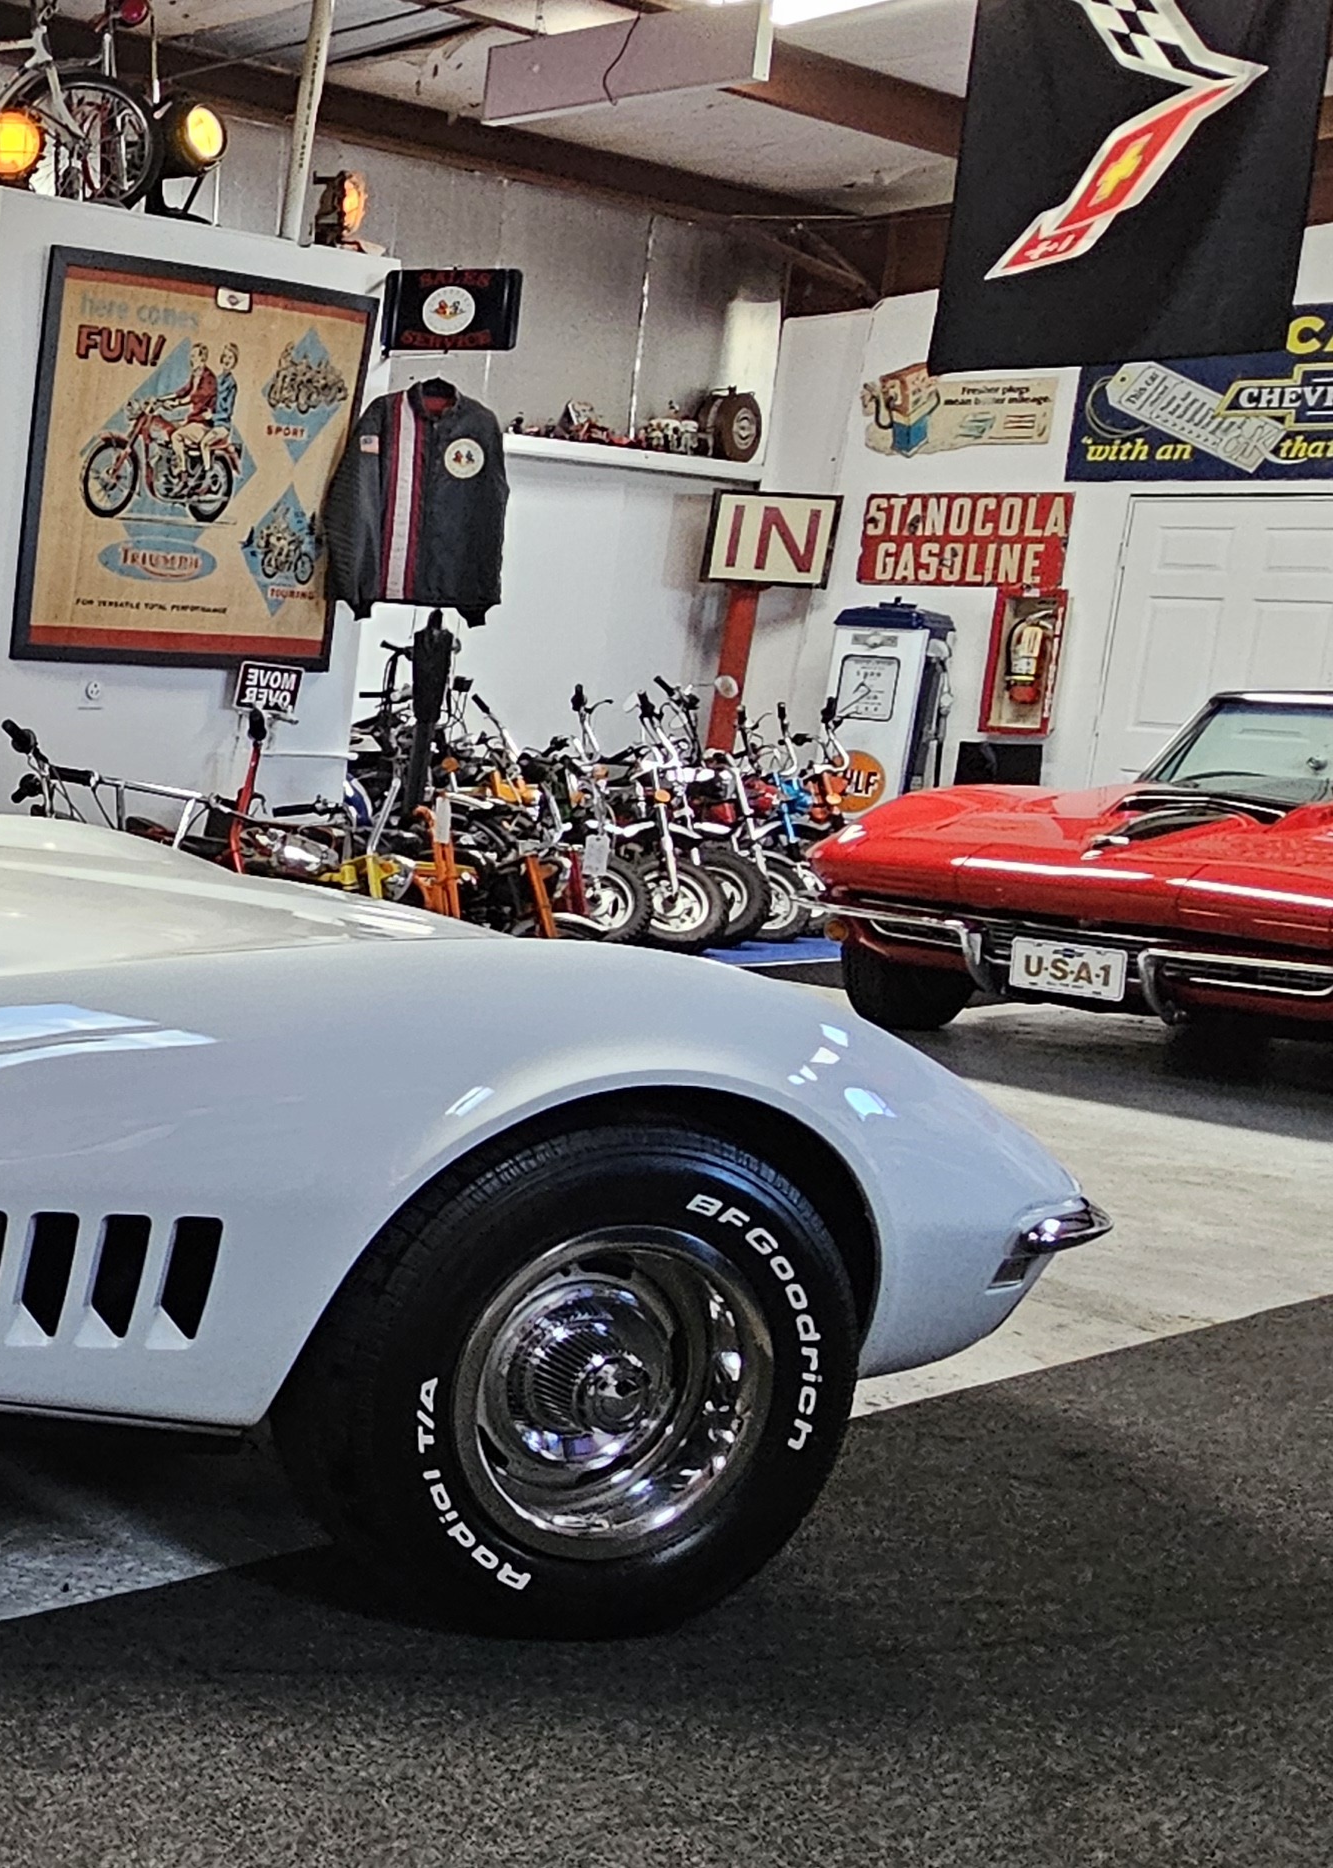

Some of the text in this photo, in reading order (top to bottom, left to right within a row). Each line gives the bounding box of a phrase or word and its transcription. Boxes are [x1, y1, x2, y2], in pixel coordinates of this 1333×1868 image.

[418, 270, 493, 288] SALES
[81, 293, 129, 317] here
[76, 324, 167, 367] FUN!
[399, 328, 494, 349] SERVICE
[1286, 315, 1333, 354] C
[266, 424, 306, 439] SPORT
[1155, 443, 1193, 461] an
[866, 496, 1068, 538] STANOCOLA
[121, 546, 201, 571] TRIUMPH
[724, 503, 822, 574] IN
[874, 541, 1046, 584] GASOLINE
[686, 1193, 823, 1451] BFGoodrich
[416, 1376, 439, 1454] T/A
[422, 1469, 532, 1590] Radial
